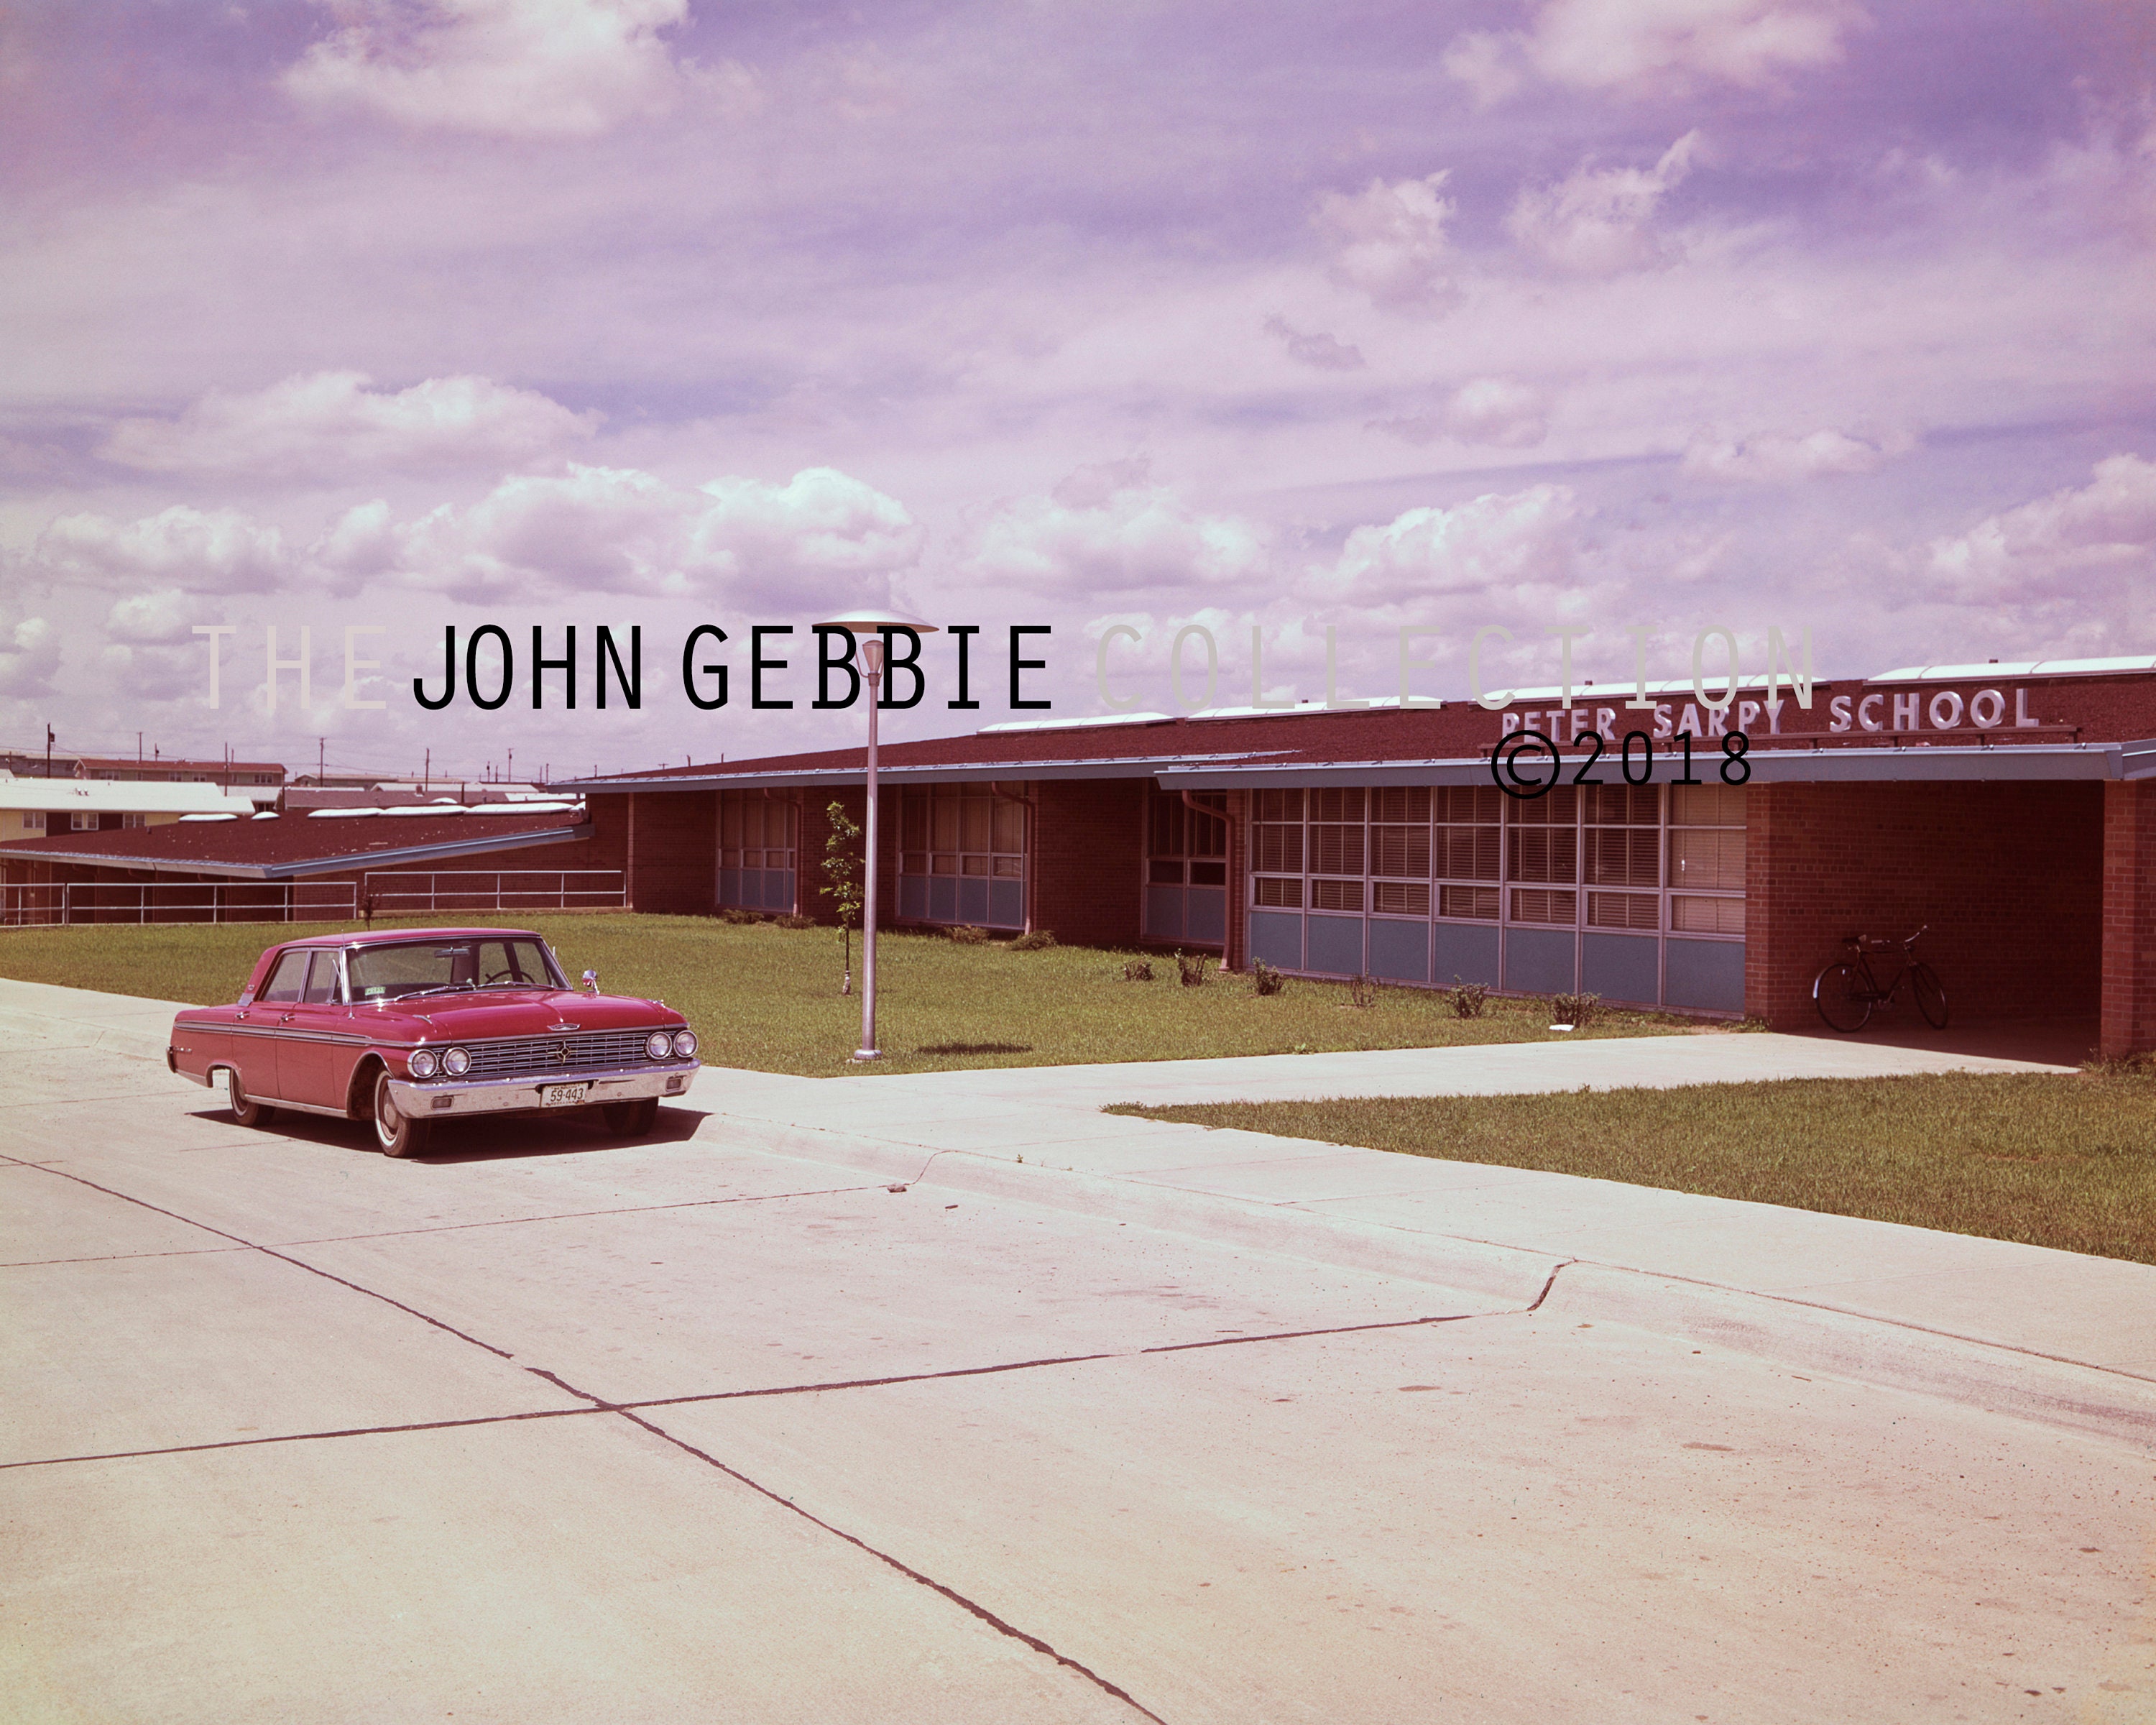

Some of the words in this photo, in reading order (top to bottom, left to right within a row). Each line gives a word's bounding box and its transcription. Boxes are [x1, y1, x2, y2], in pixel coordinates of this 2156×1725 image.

[1501, 707, 1616, 743] PETER
[1653, 699, 1785, 739] SARPY
[1829, 688, 2040, 732] SCHOOL
